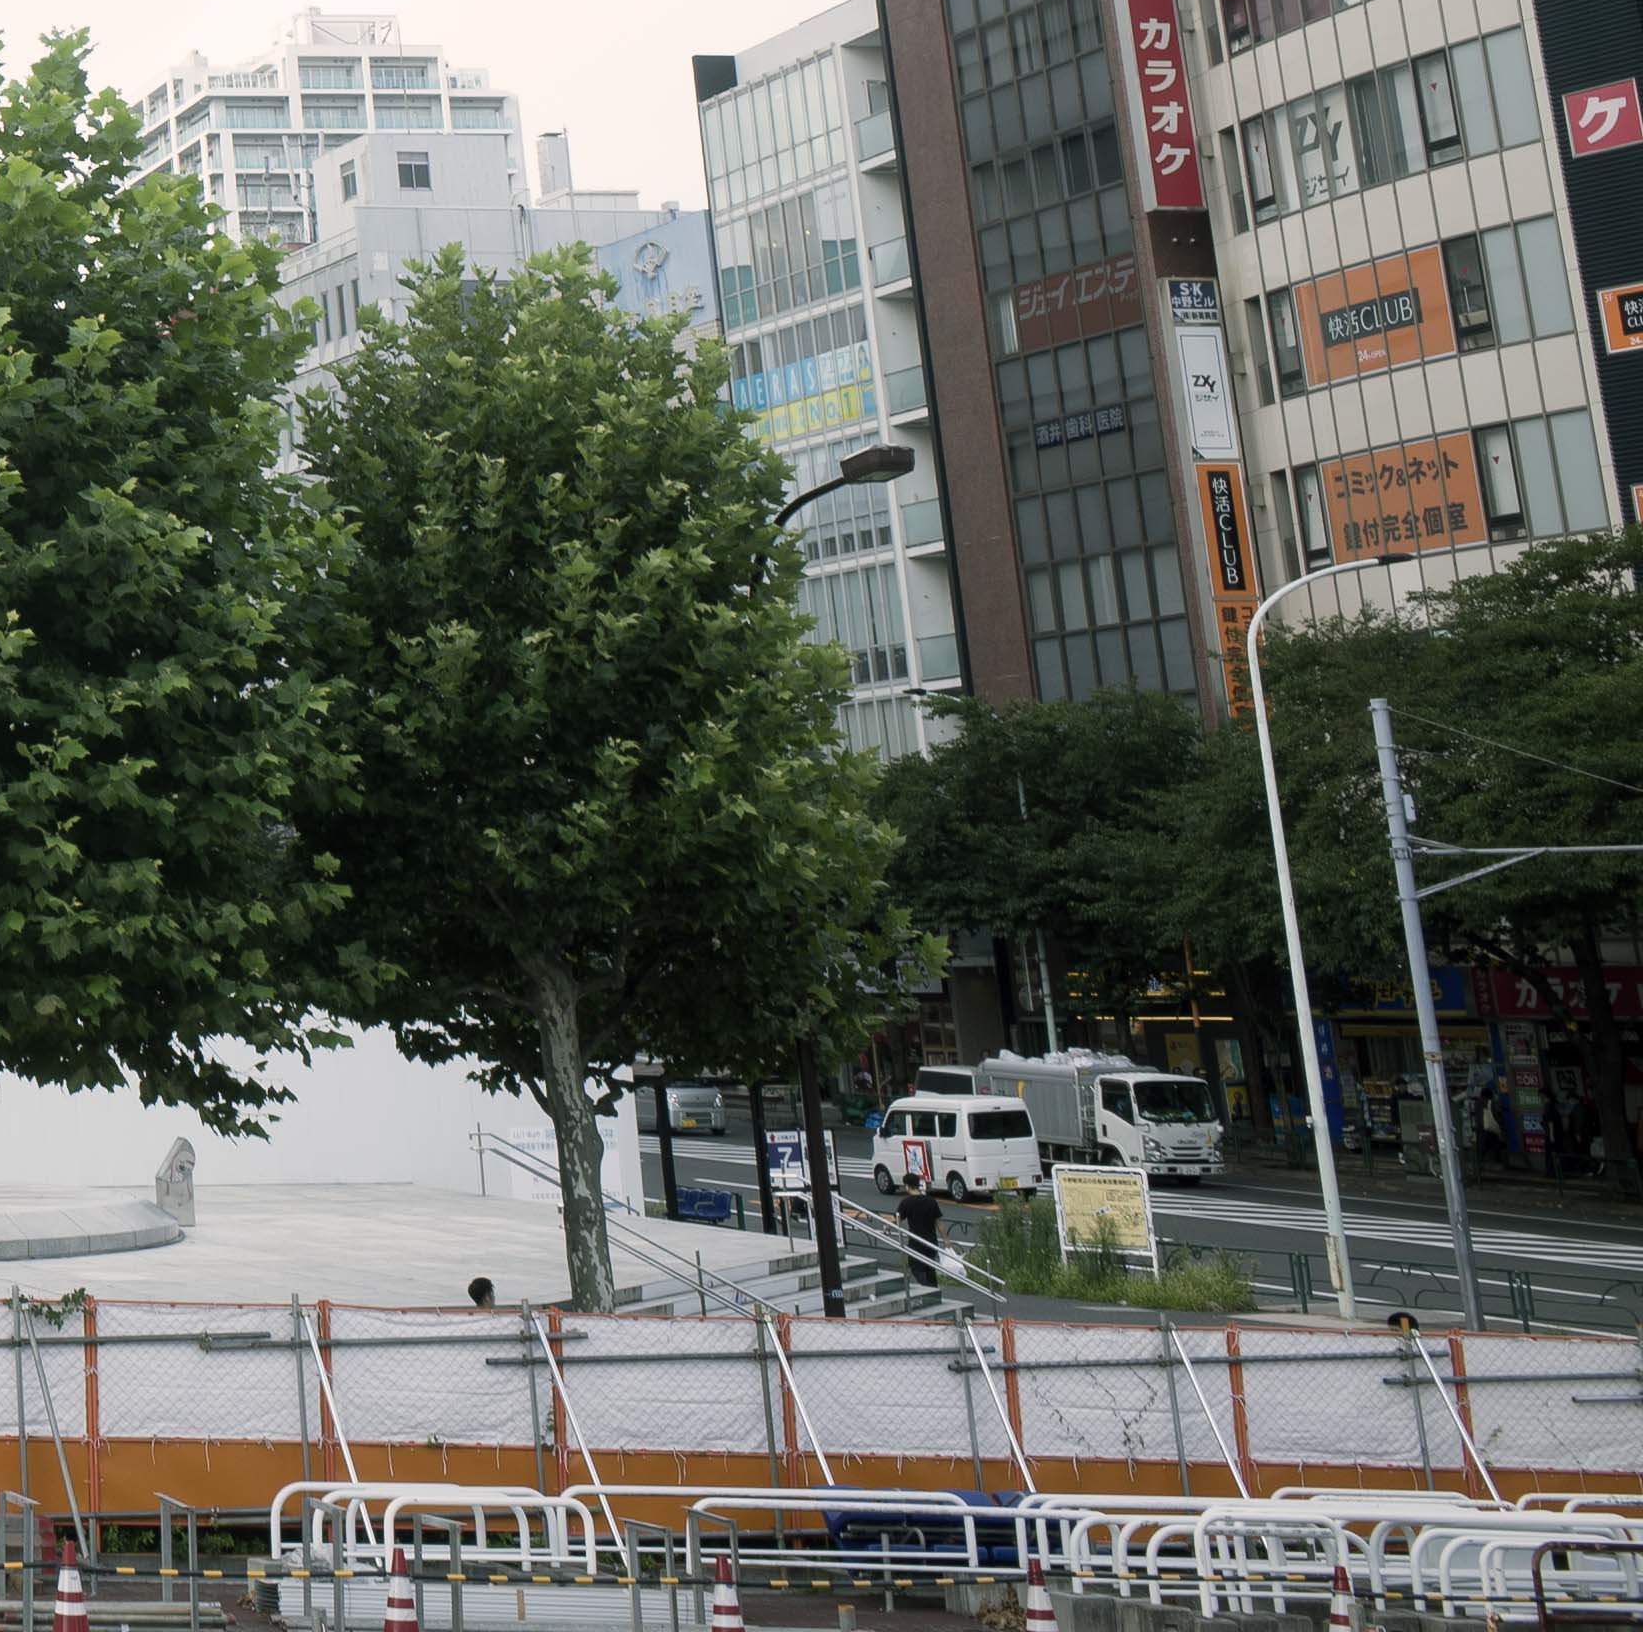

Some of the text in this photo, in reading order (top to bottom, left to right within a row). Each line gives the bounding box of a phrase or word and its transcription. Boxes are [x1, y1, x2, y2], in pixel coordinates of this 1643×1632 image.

[1138, 17, 1193, 177] カラオケ
[1171, 295, 1216, 308] 中野ビル
[1328, 295, 1414, 341] 快活CLUB
[1192, 374, 1217, 393] ZXY
[1211, 476, 1240, 585] 快活CLUB
[777, 1146, 793, 1172] 7
